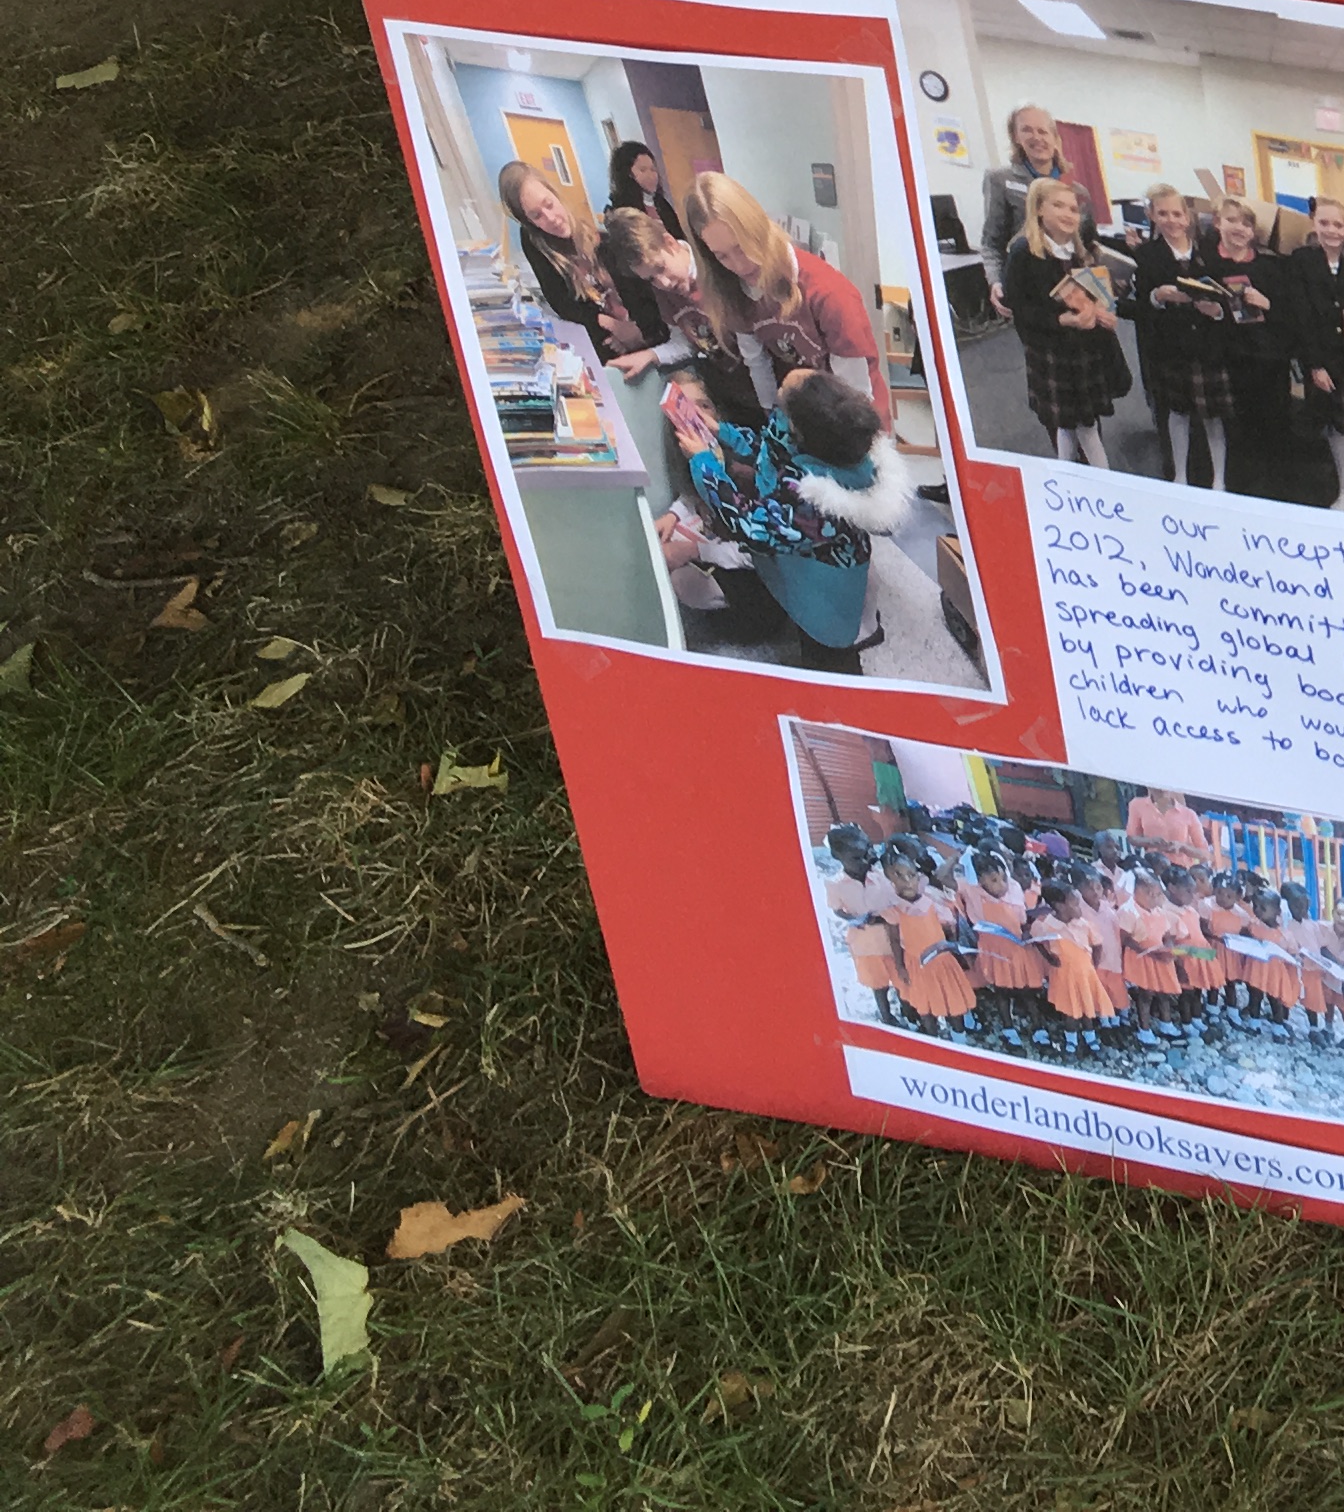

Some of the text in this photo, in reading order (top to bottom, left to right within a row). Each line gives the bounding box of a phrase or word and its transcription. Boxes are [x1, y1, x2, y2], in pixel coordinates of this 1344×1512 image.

[1044, 478, 1133, 522] Since
[1162, 514, 1220, 541] our
[1045, 525, 1146, 569] 2012,
[1165, 545, 1334, 601] Wonderland
[1048, 559, 1100, 591] has
[1120, 574, 1189, 606] been
[1056, 599, 1200, 651] spreading
[1221, 627, 1315, 666] global
[1060, 634, 1098, 668] by
[1116, 645, 1270, 698] providing
[1069, 670, 1184, 703] children
[1217, 698, 1268, 719] who
[1077, 698, 1136, 730] lack
[1152, 715, 1241, 746] access
[1263, 729, 1293, 752] to
